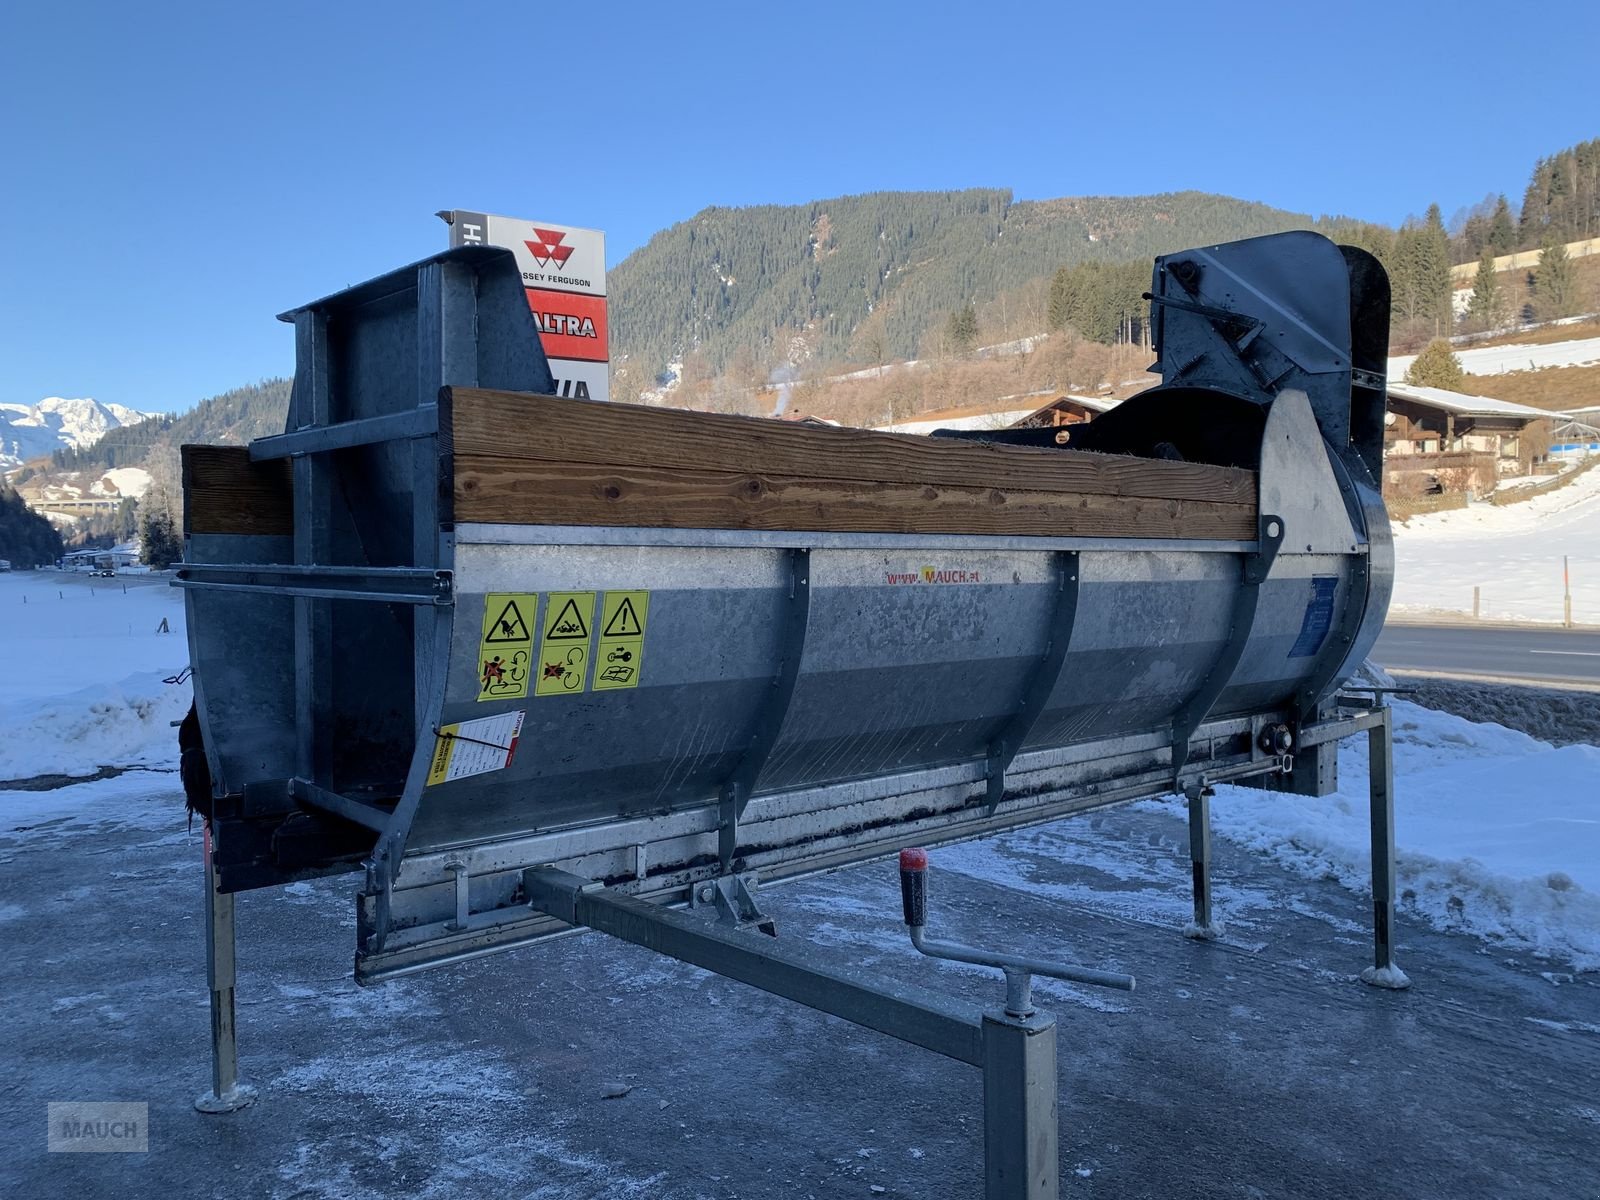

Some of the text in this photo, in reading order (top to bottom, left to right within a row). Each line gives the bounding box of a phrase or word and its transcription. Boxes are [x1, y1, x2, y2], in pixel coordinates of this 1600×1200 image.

[463, 223, 481, 245] H
[521, 272, 591, 287] SSEY FERGUSON
